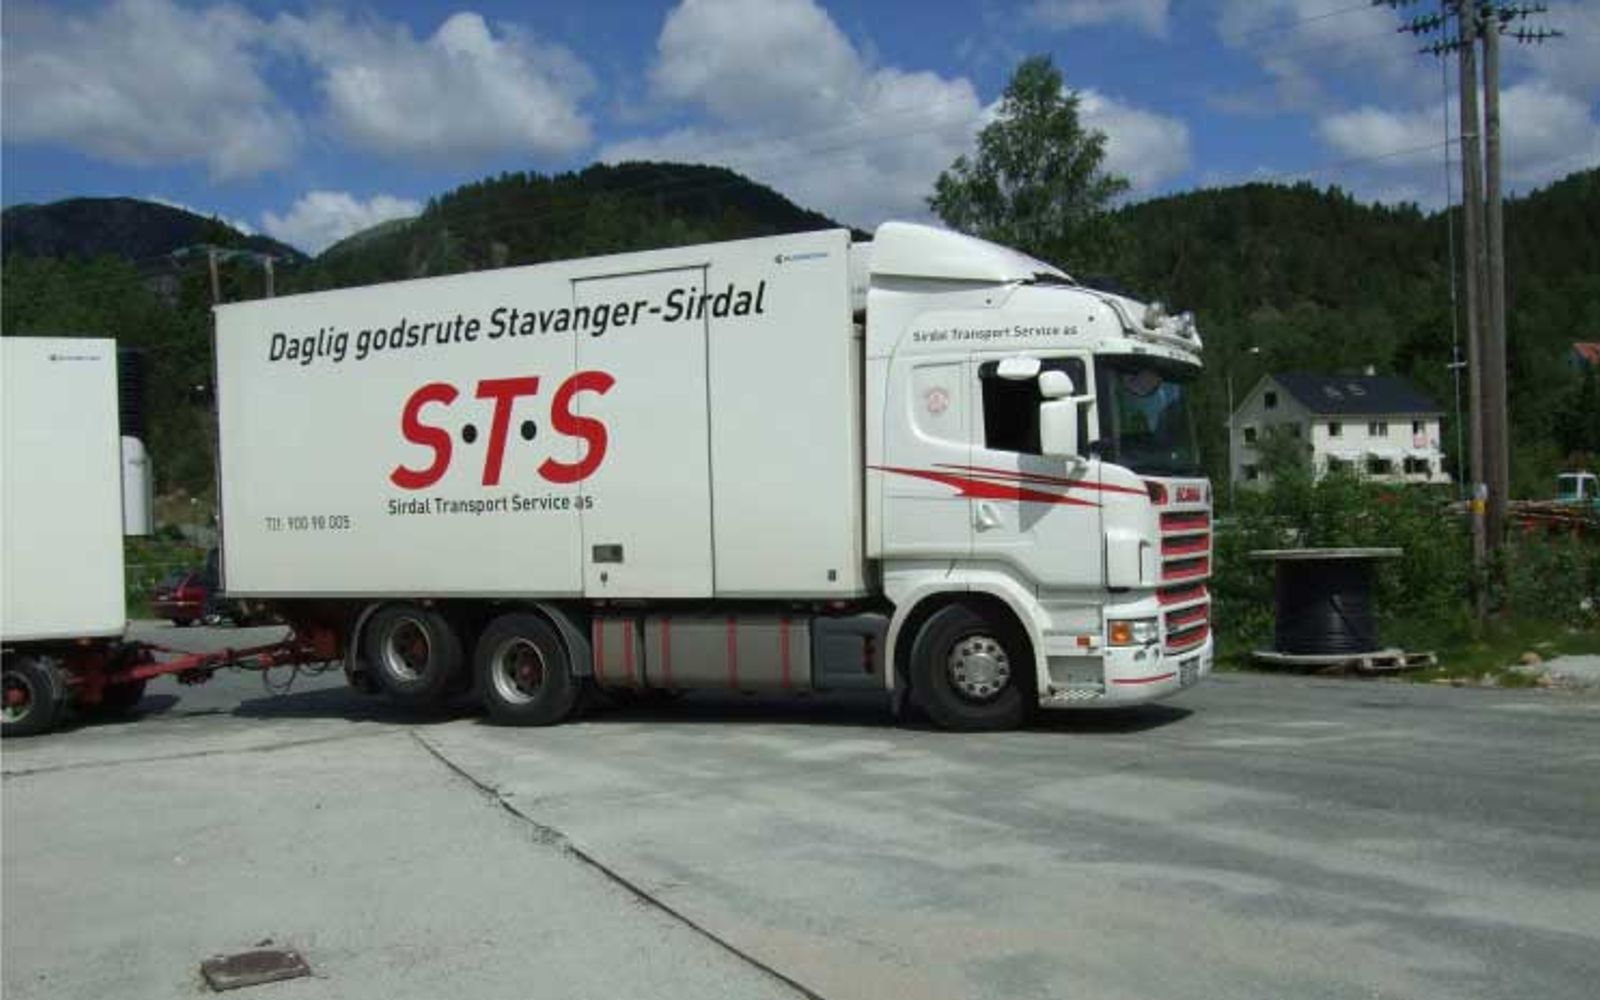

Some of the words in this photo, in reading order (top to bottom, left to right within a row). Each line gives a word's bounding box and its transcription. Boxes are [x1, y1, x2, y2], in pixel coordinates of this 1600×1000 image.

[269, 331, 349, 366] Daglig
[355, 316, 481, 361] godsrute
[487, 280, 766, 339] Stavanger-Sirdal
[951, 327, 1010, 340] Transport
[1013, 325, 1060, 337] Service
[388, 498, 432, 515] Sirdal
[434, 496, 508, 516] Transport
[511, 494, 570, 511] Service
[573, 496, 594, 510] as
